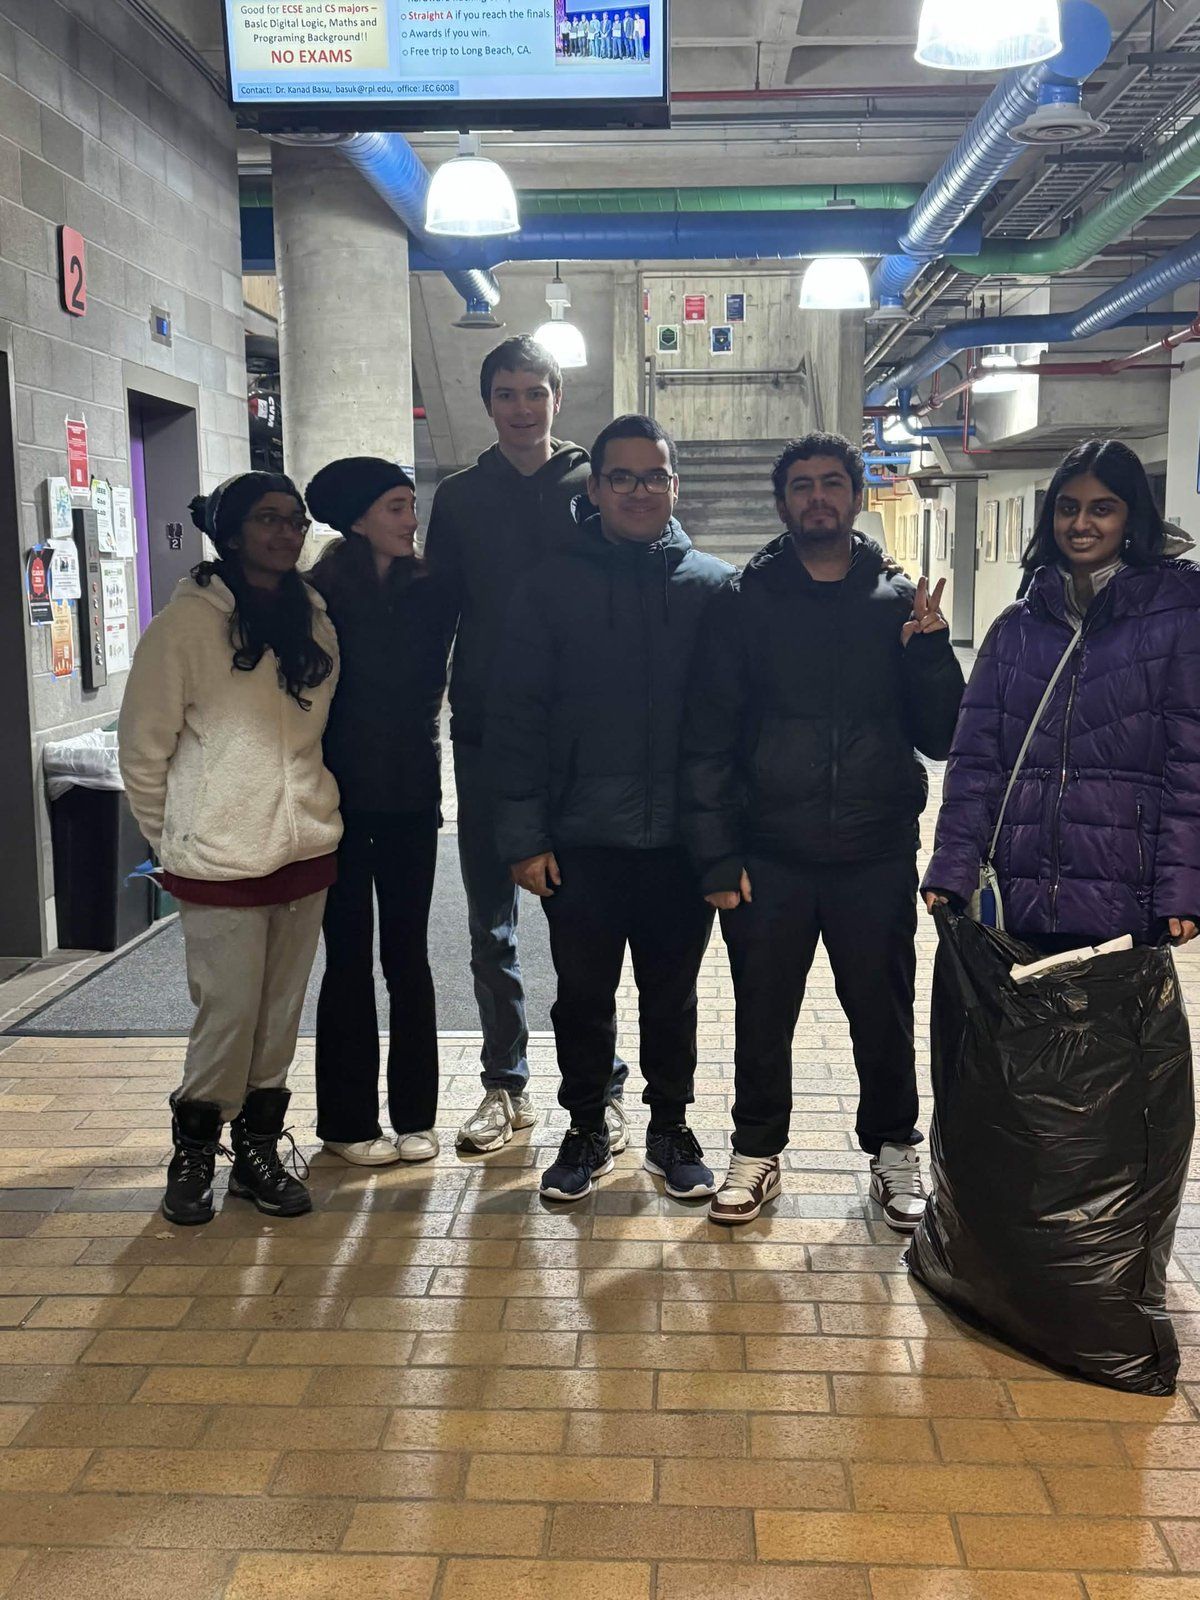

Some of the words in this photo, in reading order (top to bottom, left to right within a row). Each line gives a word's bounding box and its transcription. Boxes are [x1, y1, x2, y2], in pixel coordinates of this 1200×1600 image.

[240, 5, 264, 14] Good
[267, 4, 279, 14] for
[282, 4, 303, 14] ECSE
[306, 4, 322, 13] and
[325, 4, 336, 13] CS
[338, 4, 369, 14] majors
[408, 11, 444, 21] Straight
[446, 11, 453, 19] A
[456, 10, 461, 19] if
[463, 12, 480, 21] you
[482, 10, 507, 19] reach
[510, 9, 524, 18] the
[527, 9, 552, 18] finals.
[244, 19, 268, 28] Basic
[270, 18, 299, 29] Digital
[301, 18, 327, 29] Logic,
[329, 18, 358, 27] Maths
[360, 18, 377, 26] and
[254, 33, 305, 44] Programing
[307, 32, 368, 43] Background!!
[409, 29, 442, 38] Awards
[452, 30, 468, 39] you
[471, 28, 490, 37] win.
[271, 50, 294, 63] NO
[299, 49, 352, 63] EXAMS
[410, 47, 430, 55] Free
[432, 46, 448, 57] trip
[462, 46, 483, 56] Long
[485, 46, 514, 55] Beach,
[517, 46, 532, 54] CA.
[312, 86, 332, 94] Basu,
[397, 84, 419, 92] office:
[422, 84, 434, 92] JEC
[436, 84, 455, 92] 6008
[70, 255, 83, 311] 2
[172, 538, 179, 548] 2
